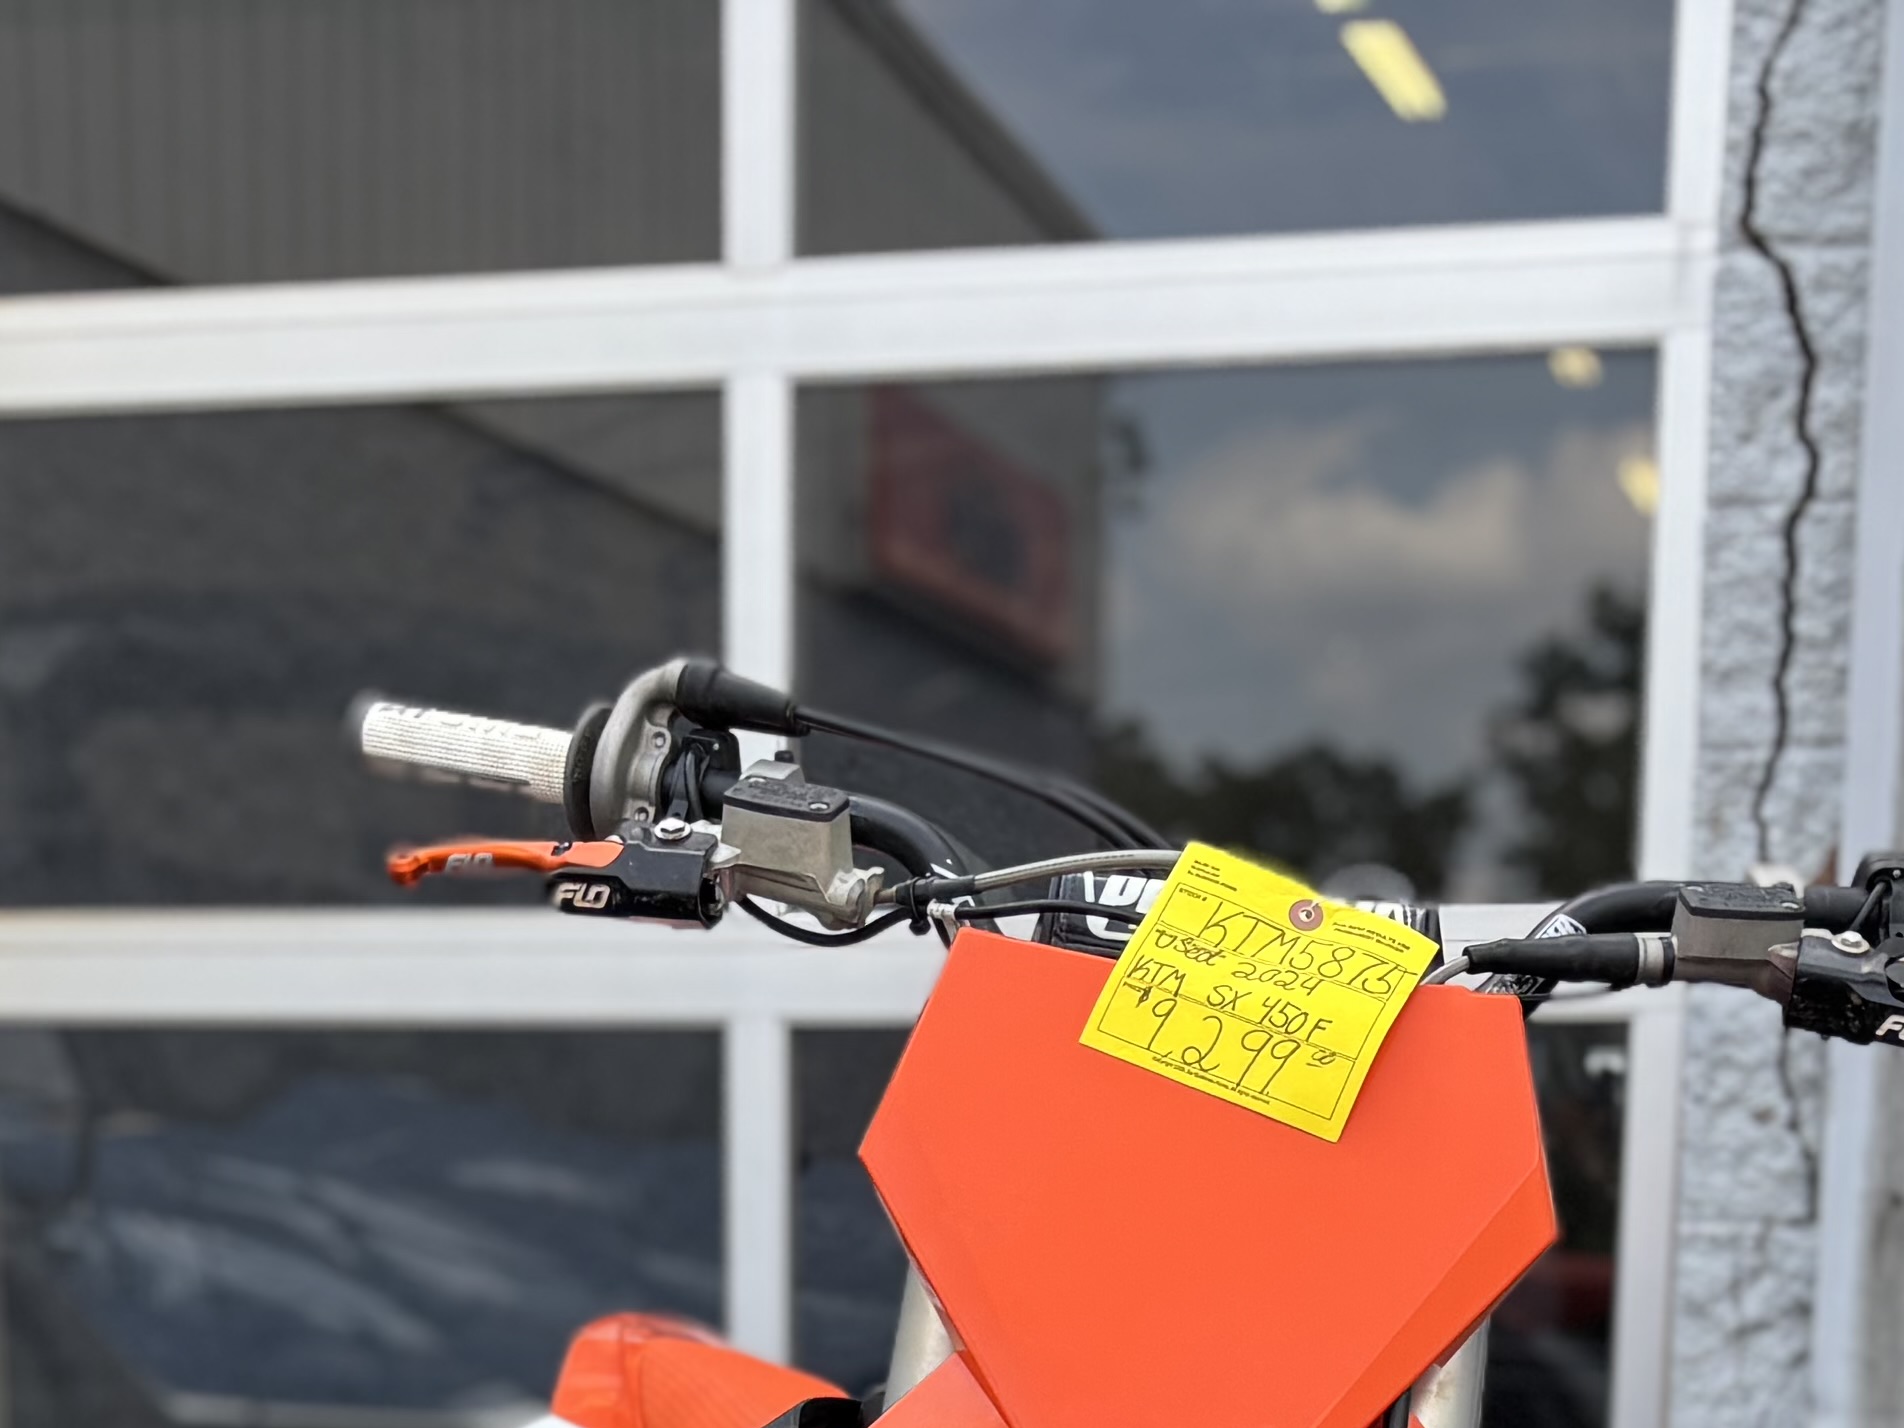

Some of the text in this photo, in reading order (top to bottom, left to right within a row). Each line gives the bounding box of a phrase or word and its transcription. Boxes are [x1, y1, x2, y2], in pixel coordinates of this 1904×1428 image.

[554, 881, 611, 909] FLO
[1126, 954, 1187, 998] KTM
[1206, 984, 1253, 1012] SX
[1231, 962, 1326, 997] 2024
